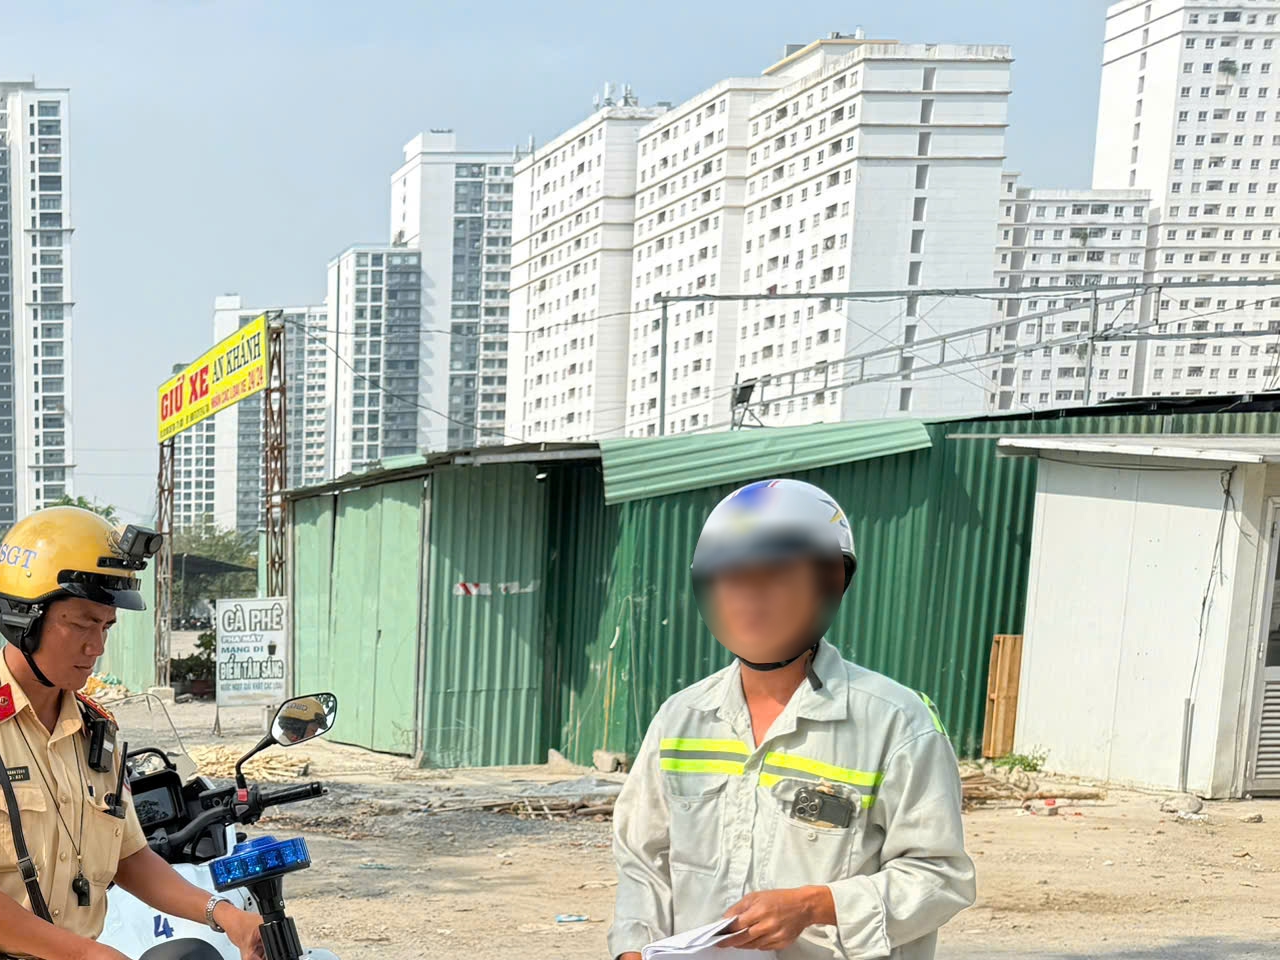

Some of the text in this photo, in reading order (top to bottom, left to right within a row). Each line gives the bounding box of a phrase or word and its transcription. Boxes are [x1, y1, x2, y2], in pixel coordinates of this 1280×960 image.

[161, 374, 185, 421] GIỮ
[189, 364, 209, 405] XE
[212, 356, 224, 384] AN
[226, 332, 261, 375] KHÁNH
[222, 602, 284, 632] CÀ PHÊ
[221, 645, 250, 654] MANG
[241, 656, 261, 679] TÂM
[260, 655, 284, 679] SÁNG
[153, 914, 175, 939] 4
